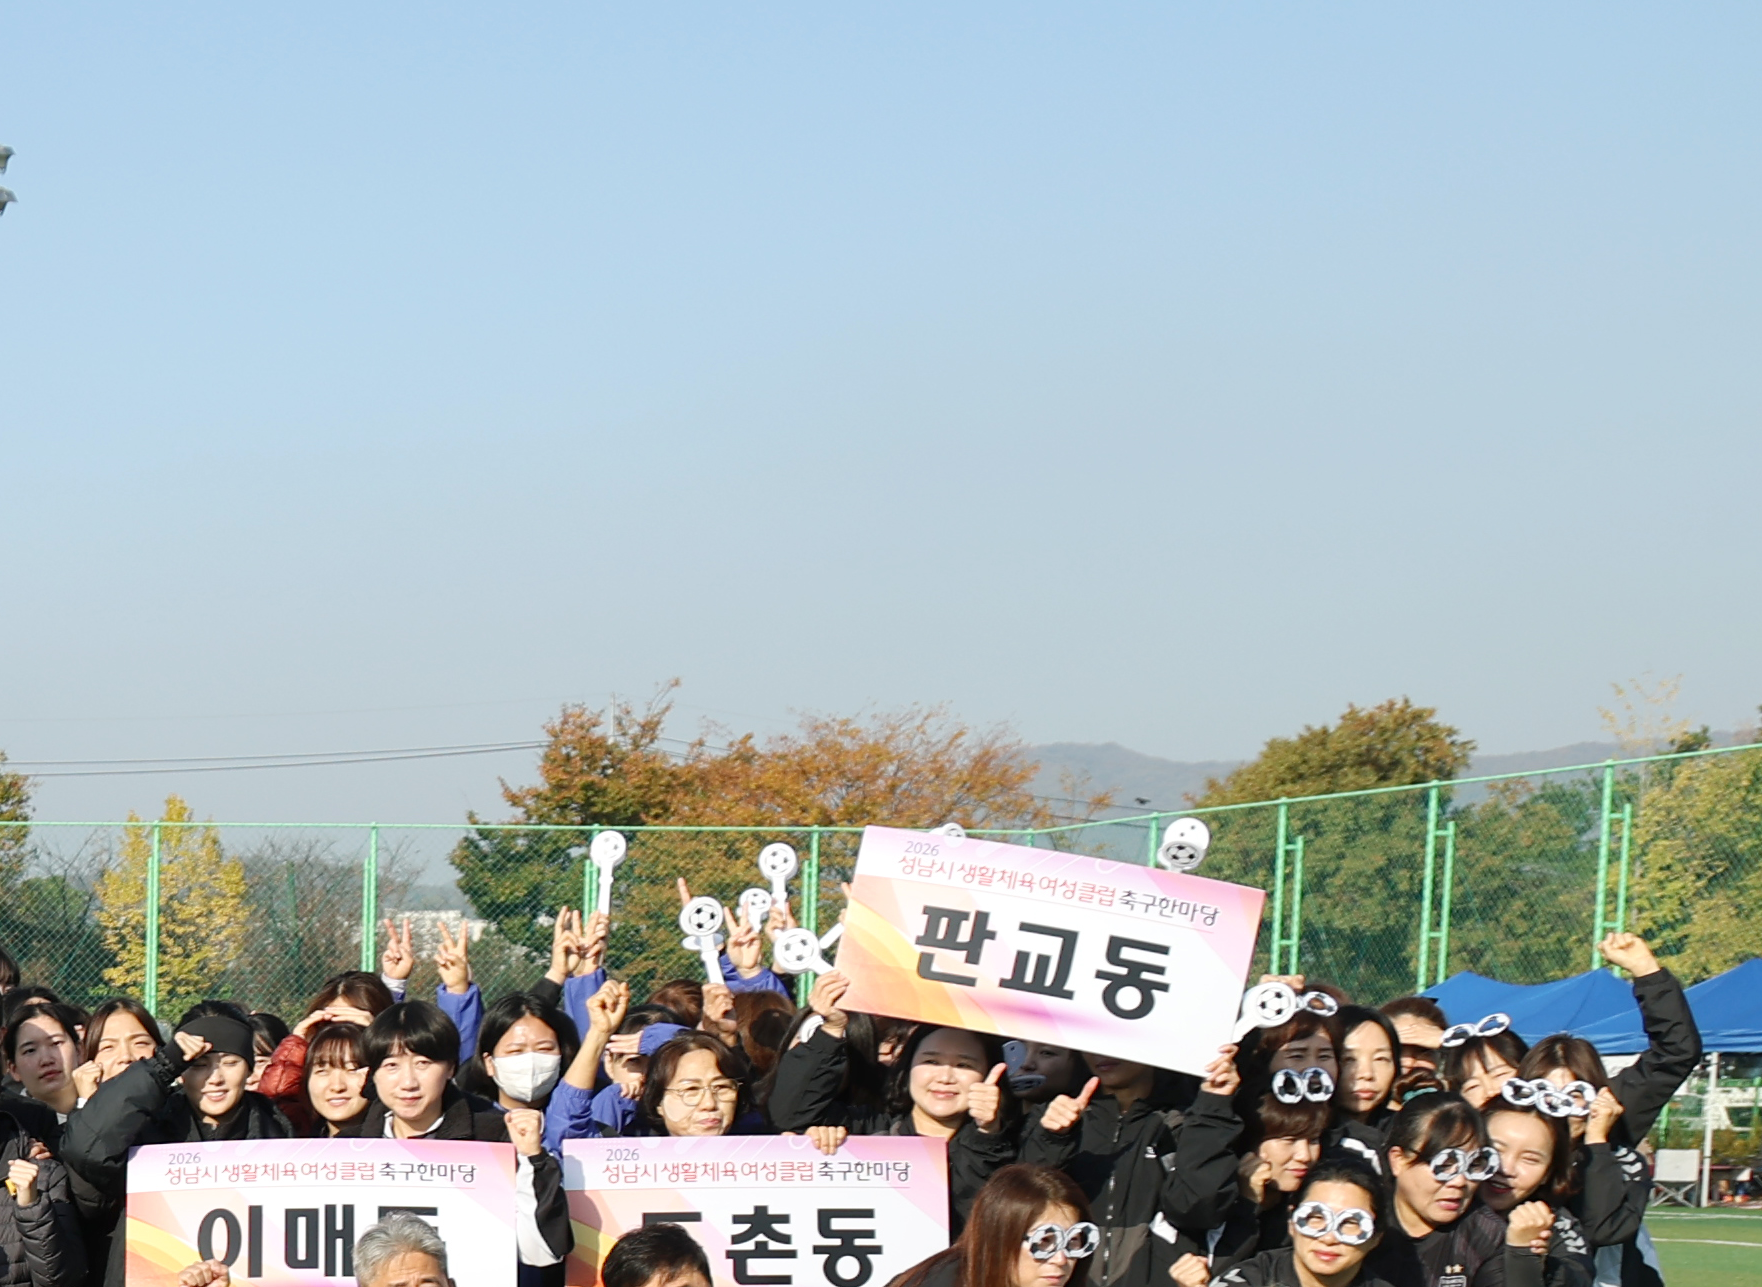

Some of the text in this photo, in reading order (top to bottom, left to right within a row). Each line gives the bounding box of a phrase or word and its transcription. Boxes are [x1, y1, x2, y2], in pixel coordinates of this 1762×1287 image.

[904, 840, 940, 857] 2026
[898, 855, 1220, 926] 성남시 생활체육 여성클럽 축구한마당
[915, 905, 1171, 1020] 판교동
[168, 1152, 201, 1166] 2026
[606, 1148, 639, 1162] 2026
[164, 1161, 477, 1186] 성남시 생활체육 여성클럽 축구한마당
[602, 1161, 911, 1184] 성남시 생활체육 여성클럽 축구한마당
[197, 1204, 446, 1278] 이매
